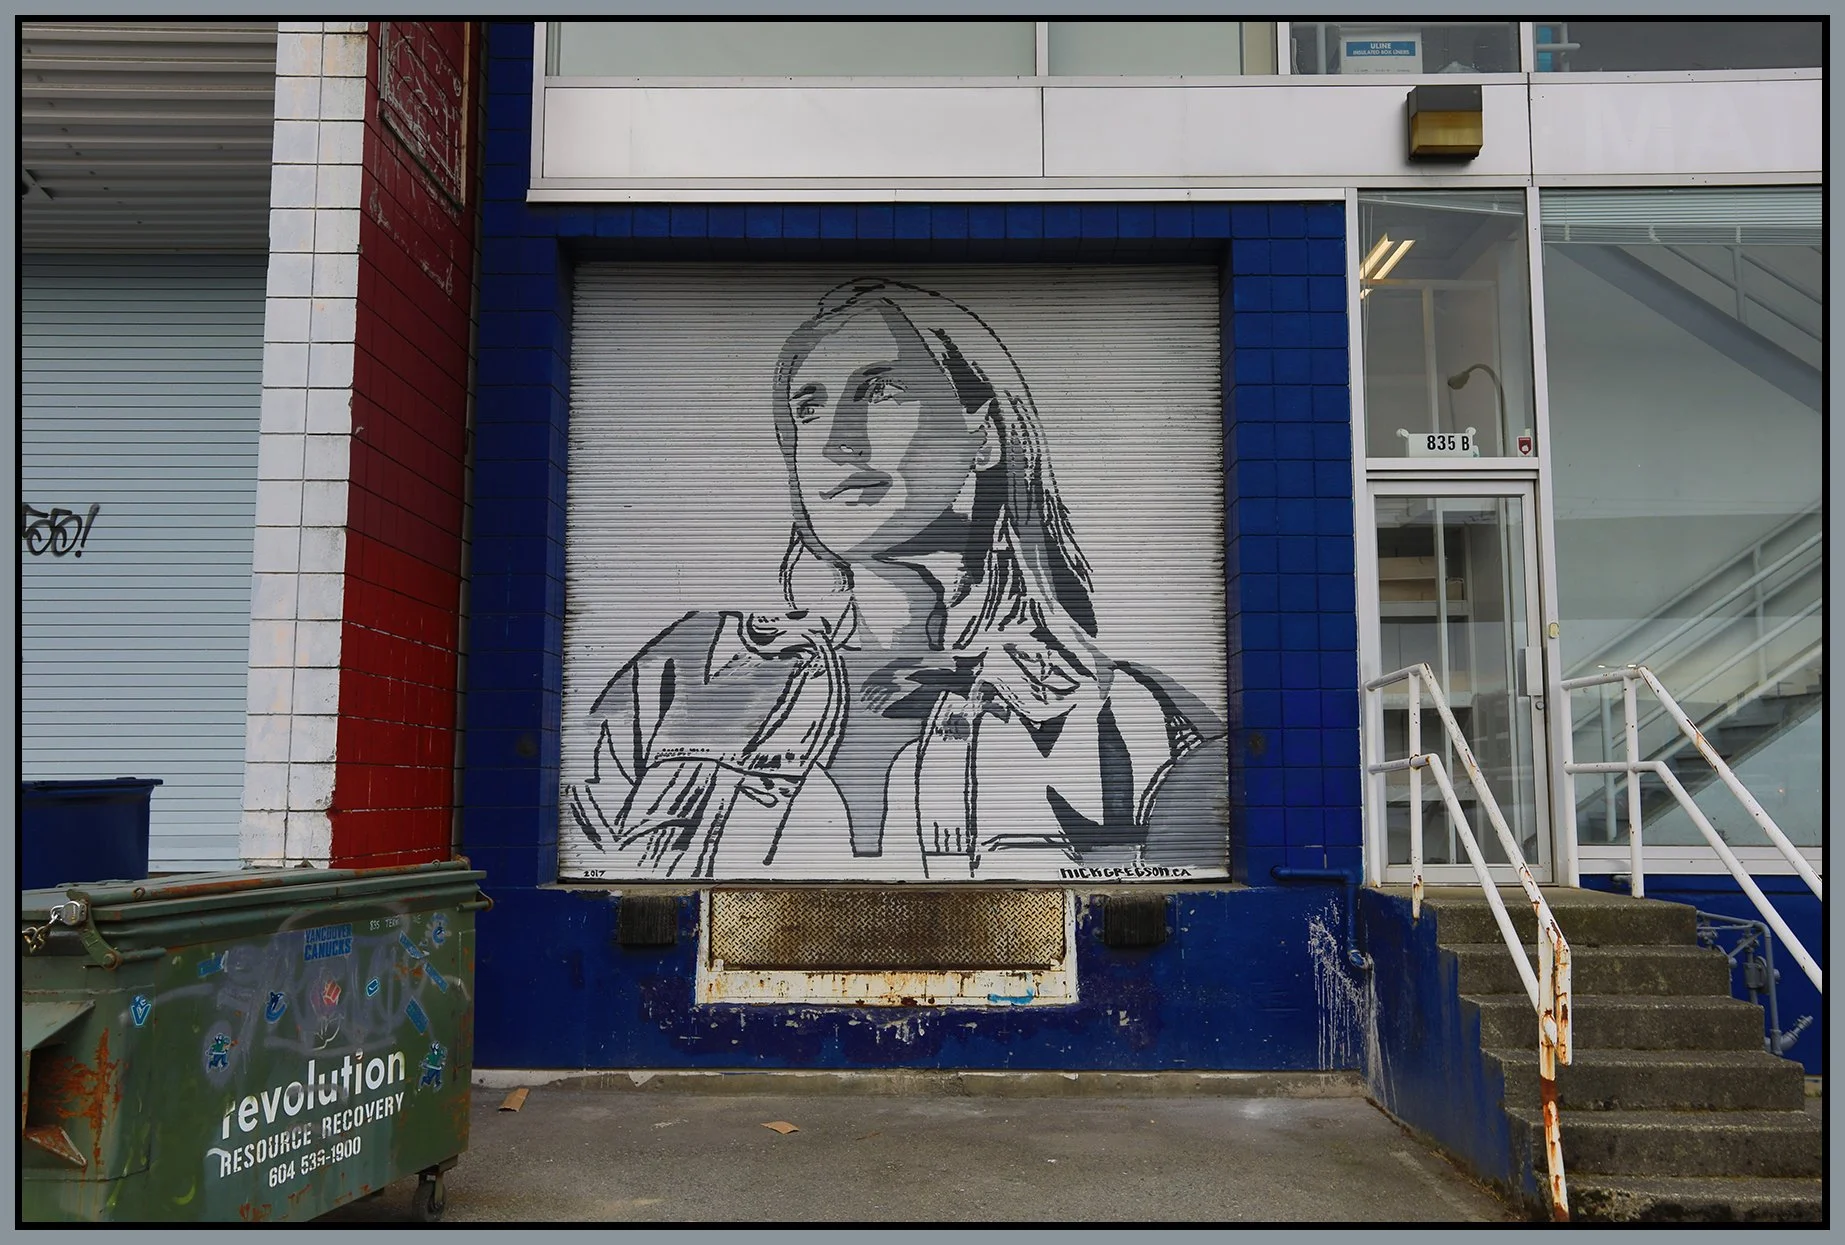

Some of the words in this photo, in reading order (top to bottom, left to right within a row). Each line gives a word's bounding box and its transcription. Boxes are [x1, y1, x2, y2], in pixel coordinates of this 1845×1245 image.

[1427, 435, 1456, 451] 835
[1461, 435, 1470, 451] B
[305, 923, 353, 943] VANCOUVER
[304, 937, 353, 961] CANUCKS
[222, 1048, 406, 1140] revolution
[208, 1122, 313, 1178] RESOURCE
[321, 1091, 405, 1139] RECOVERY
[268, 1160, 296, 1188] 604
